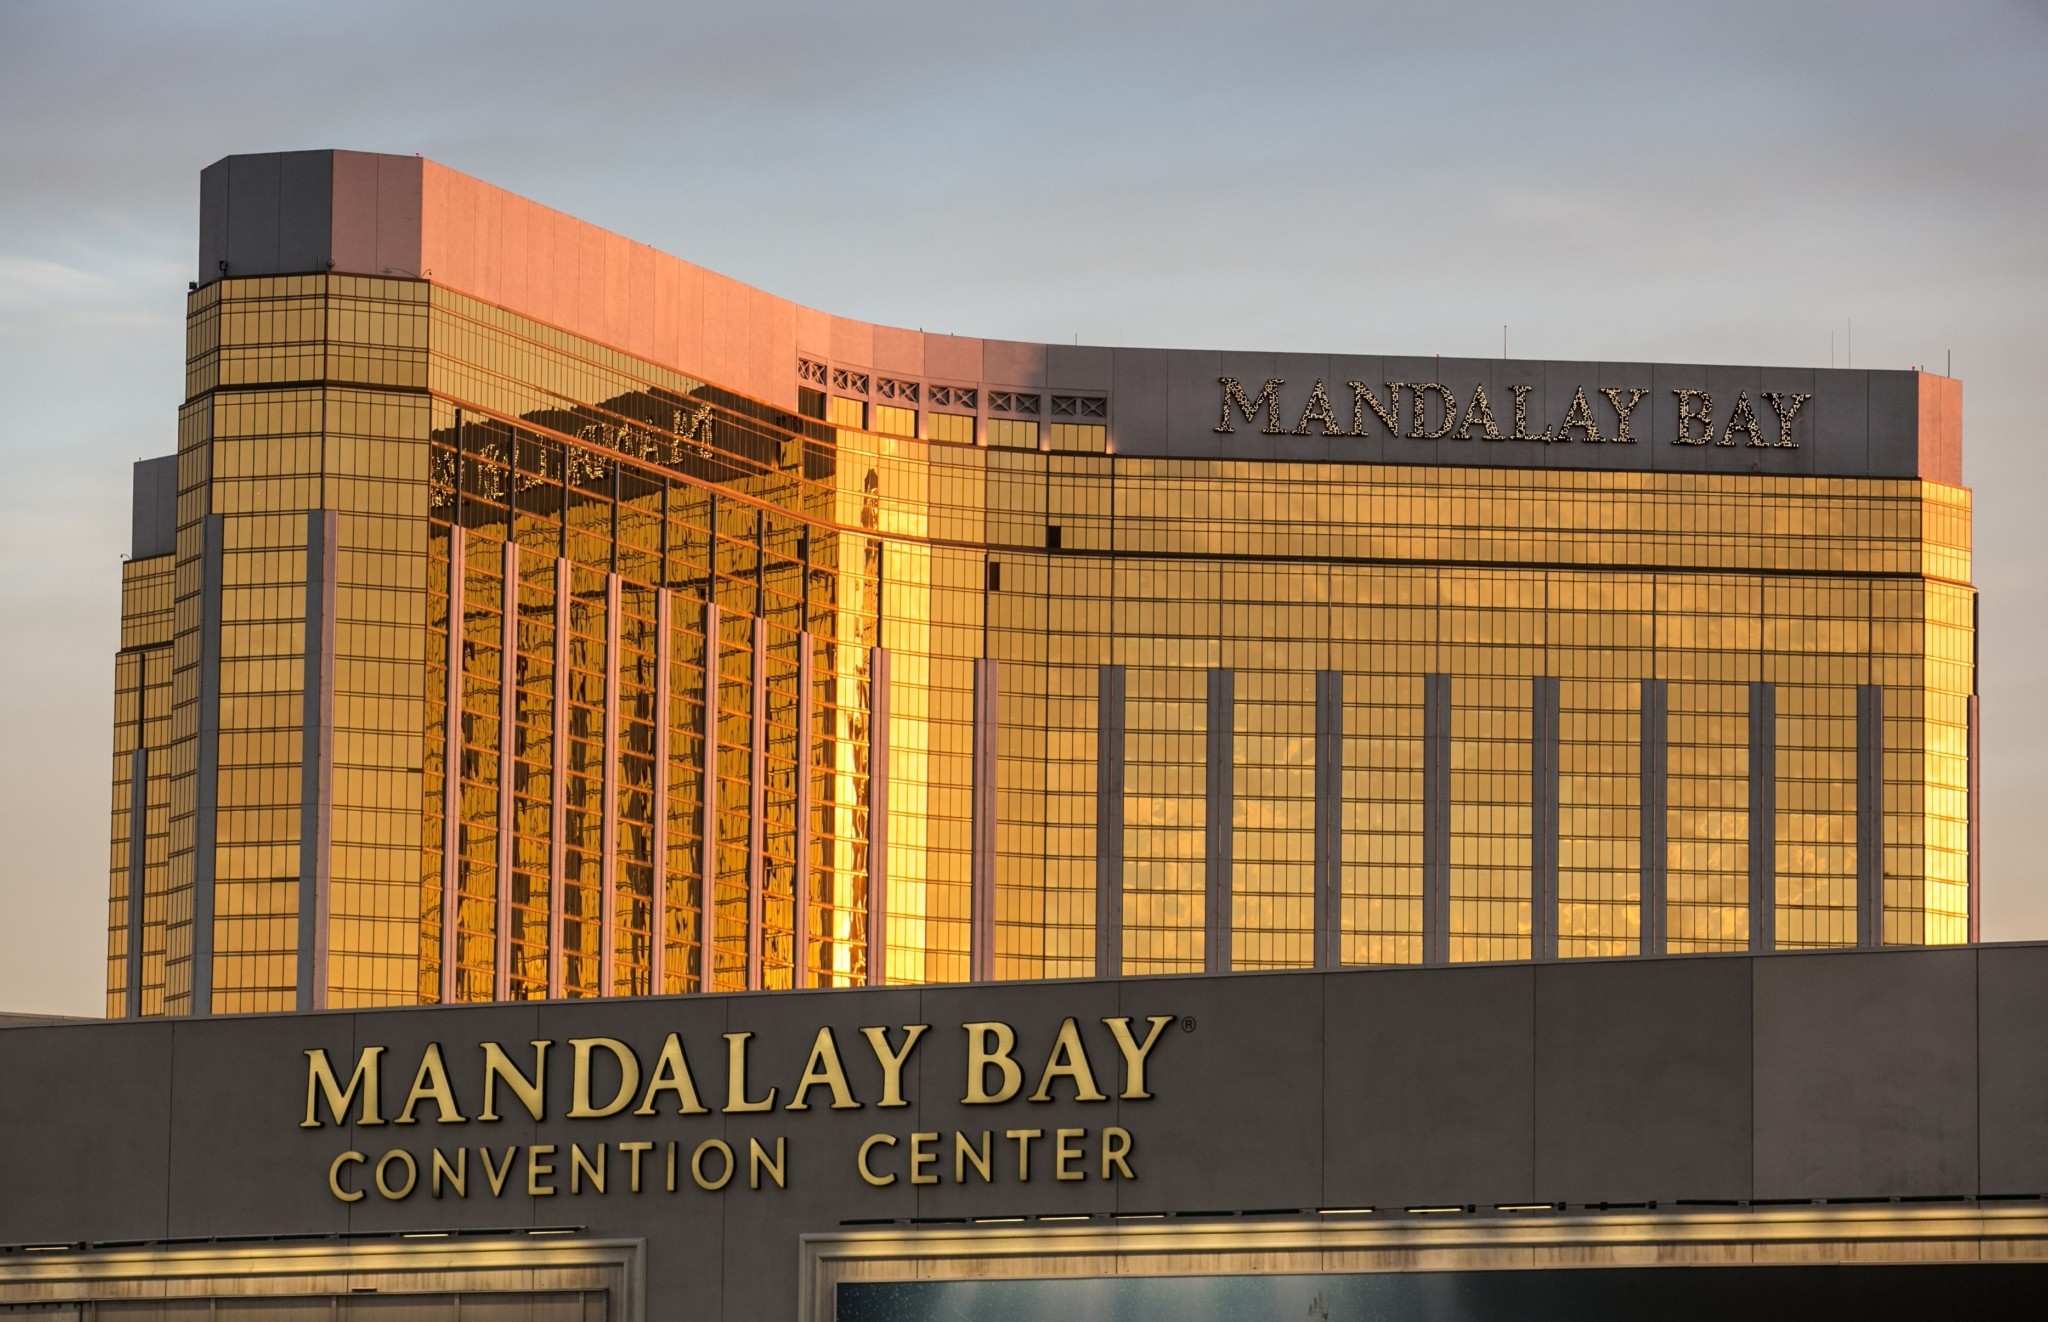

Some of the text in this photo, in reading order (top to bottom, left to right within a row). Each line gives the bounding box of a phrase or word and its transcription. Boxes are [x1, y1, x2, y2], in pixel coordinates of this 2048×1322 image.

[1213, 376, 1811, 449] MANDALAY BAY
[301, 1025, 929, 1127] MANDALAY
[328, 1126, 1136, 1202] CONVENTION CENTER
